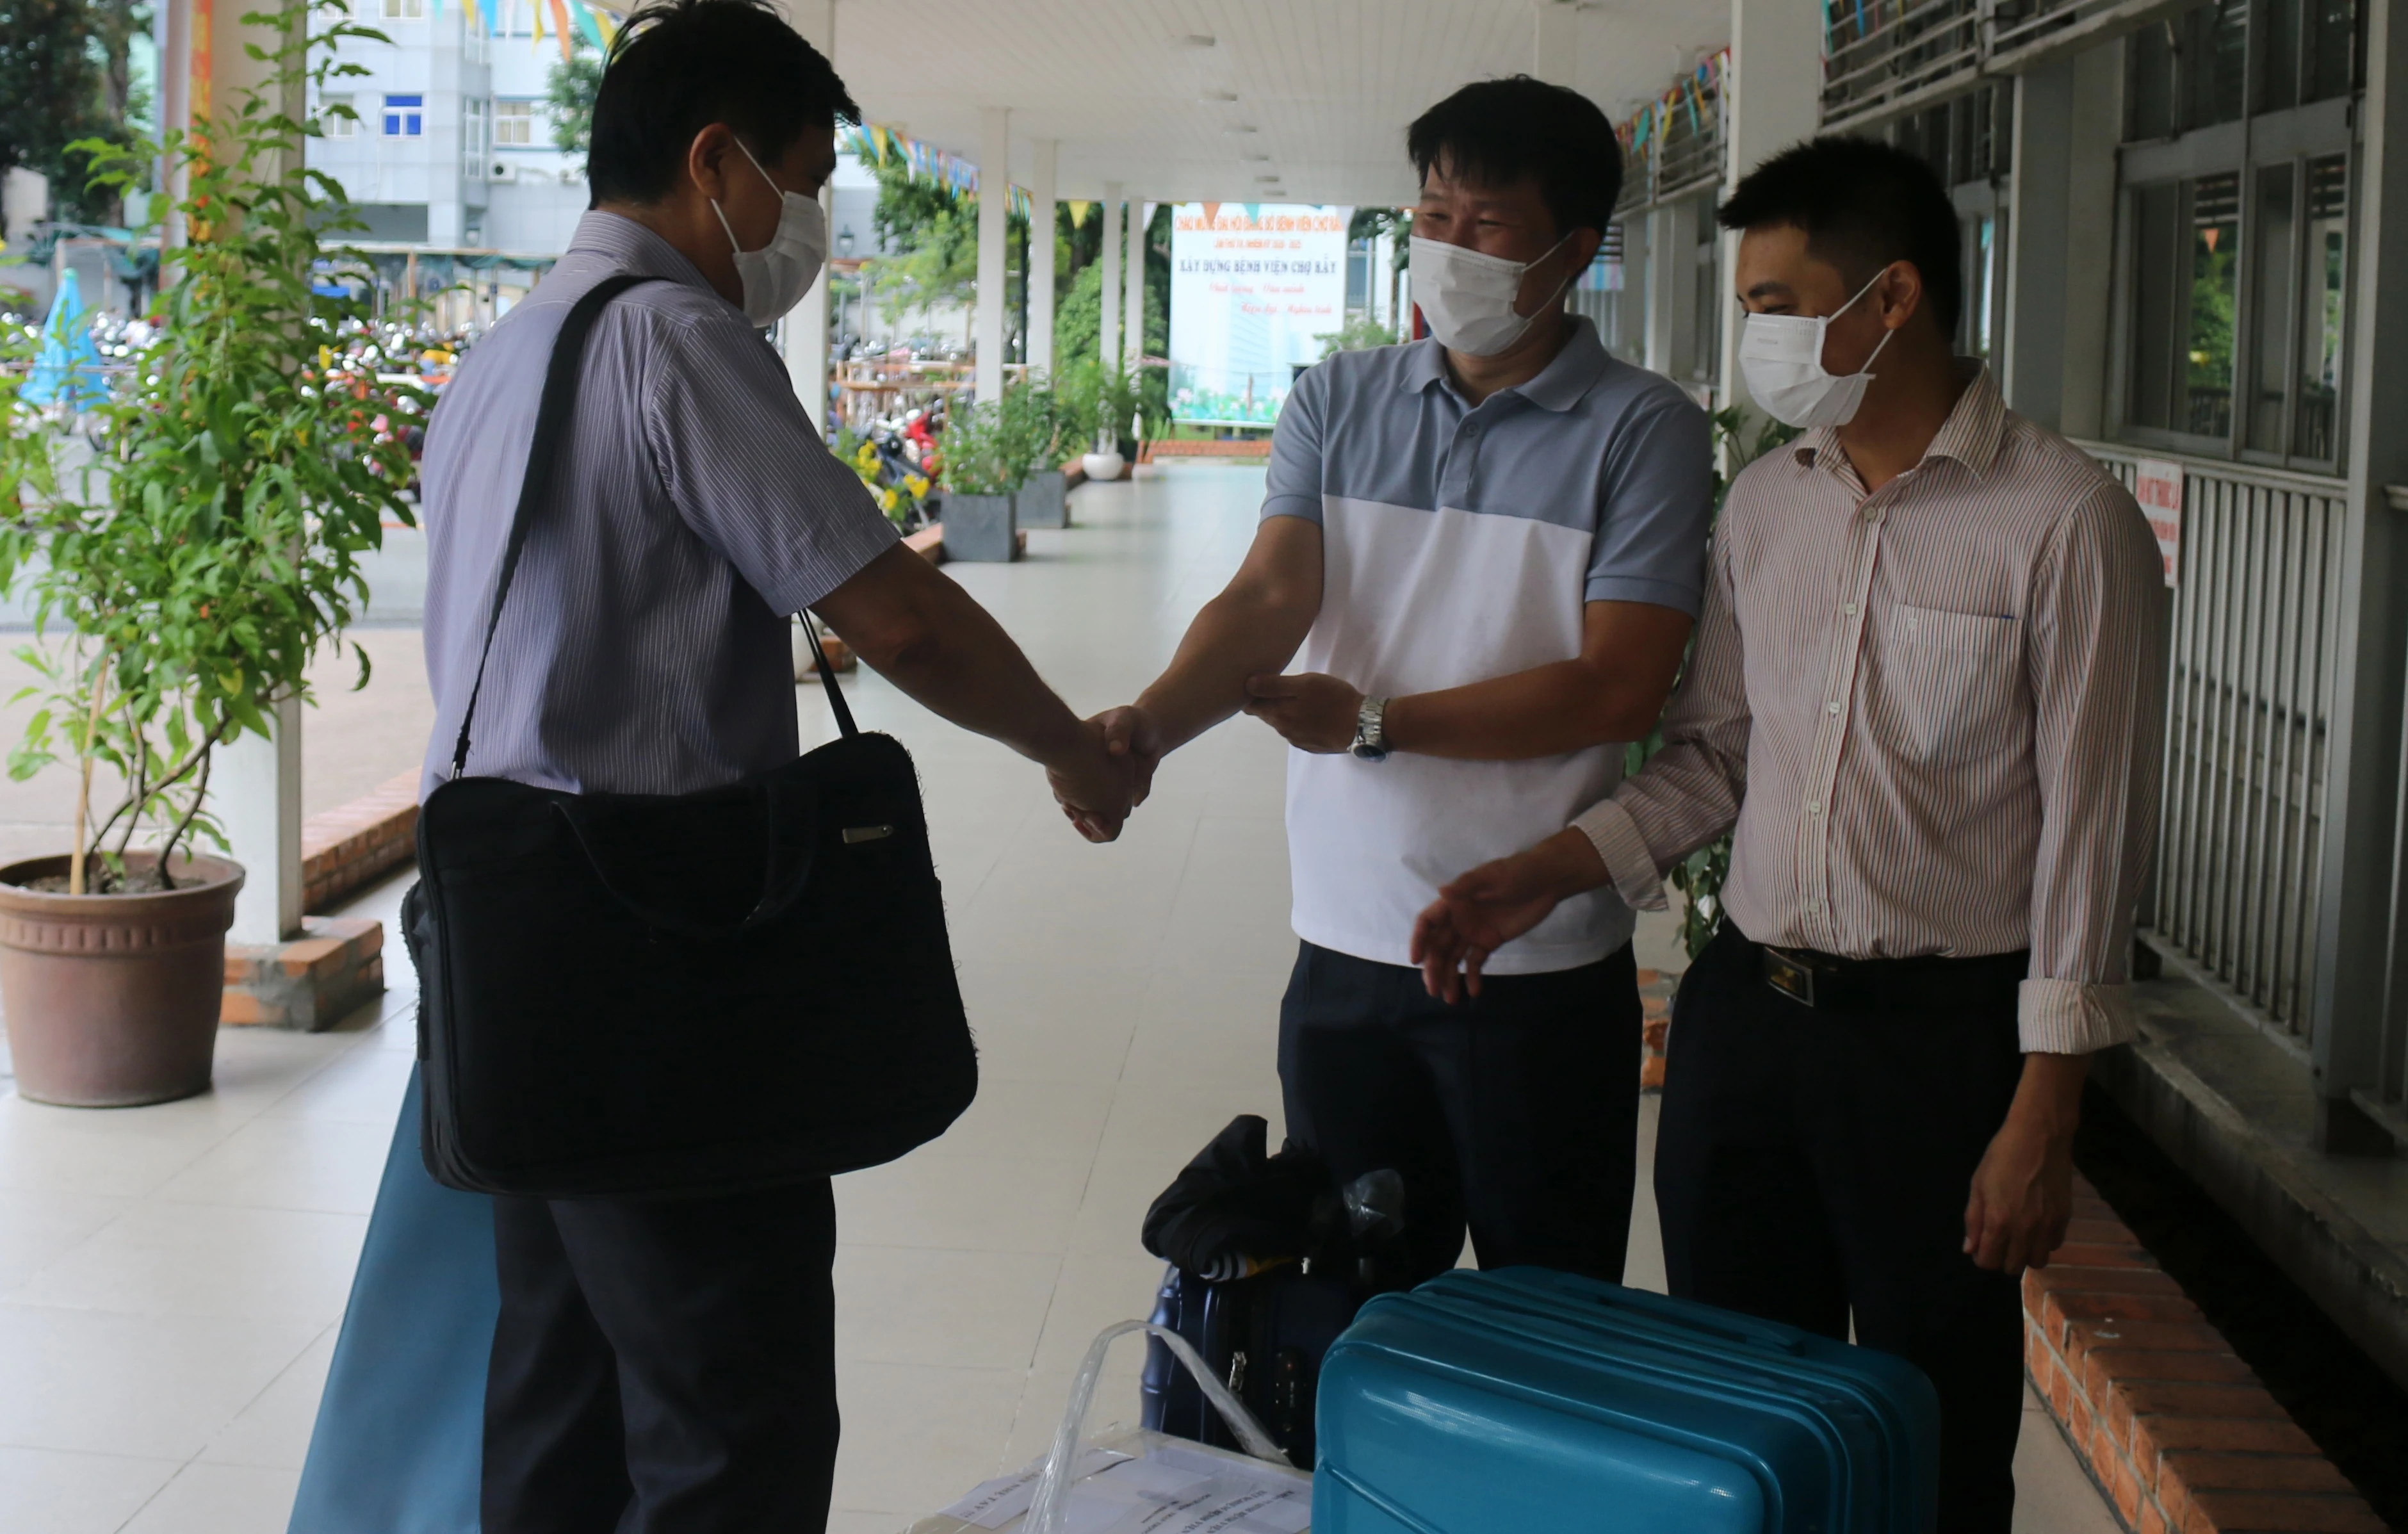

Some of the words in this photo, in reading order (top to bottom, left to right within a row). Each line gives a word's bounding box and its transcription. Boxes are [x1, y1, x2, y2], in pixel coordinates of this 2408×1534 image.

[1180, 256, 1200, 272] XÂY
[1203, 257, 1231, 274] DỰNG
[1234, 256, 1261, 274] BỆNH
[1264, 256, 1288, 275] VIỆN
[1290, 258, 1312, 275] CHỢ
